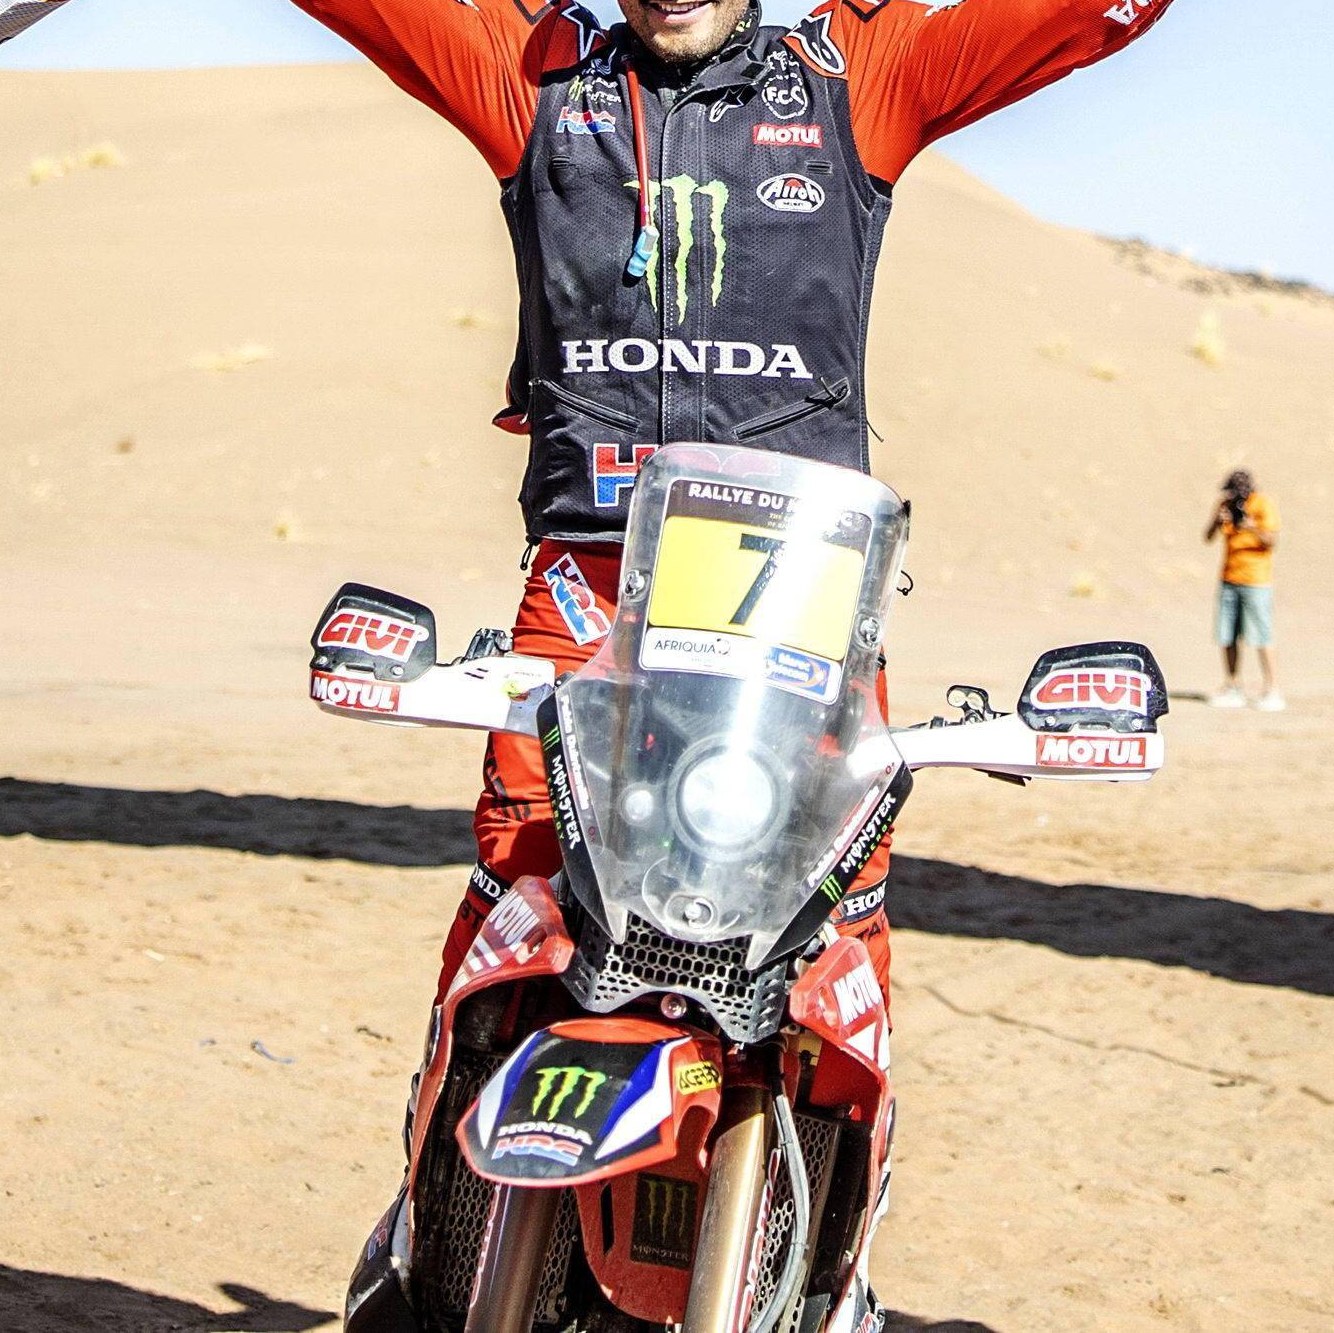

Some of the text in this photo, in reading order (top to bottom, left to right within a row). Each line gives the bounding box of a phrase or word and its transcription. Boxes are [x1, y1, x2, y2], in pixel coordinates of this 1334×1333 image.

[756, 125, 820, 145] MOTUL
[561, 337, 814, 380] HONDA
[688, 483, 784, 510] RALLYE DU
[728, 532, 787, 626] 7
[320, 612, 416, 657] GIVI
[654, 639, 716, 655] AFRIQUIA
[312, 676, 395, 710] MOTUL
[1036, 673, 1142, 708] GIVI
[1040, 737, 1144, 764] MOTUL
[551, 753, 582, 850] MONSTER
[840, 792, 897, 874] MONSTER
[491, 1133, 585, 1167] HRC
[497, 1120, 594, 1146] HONDA
